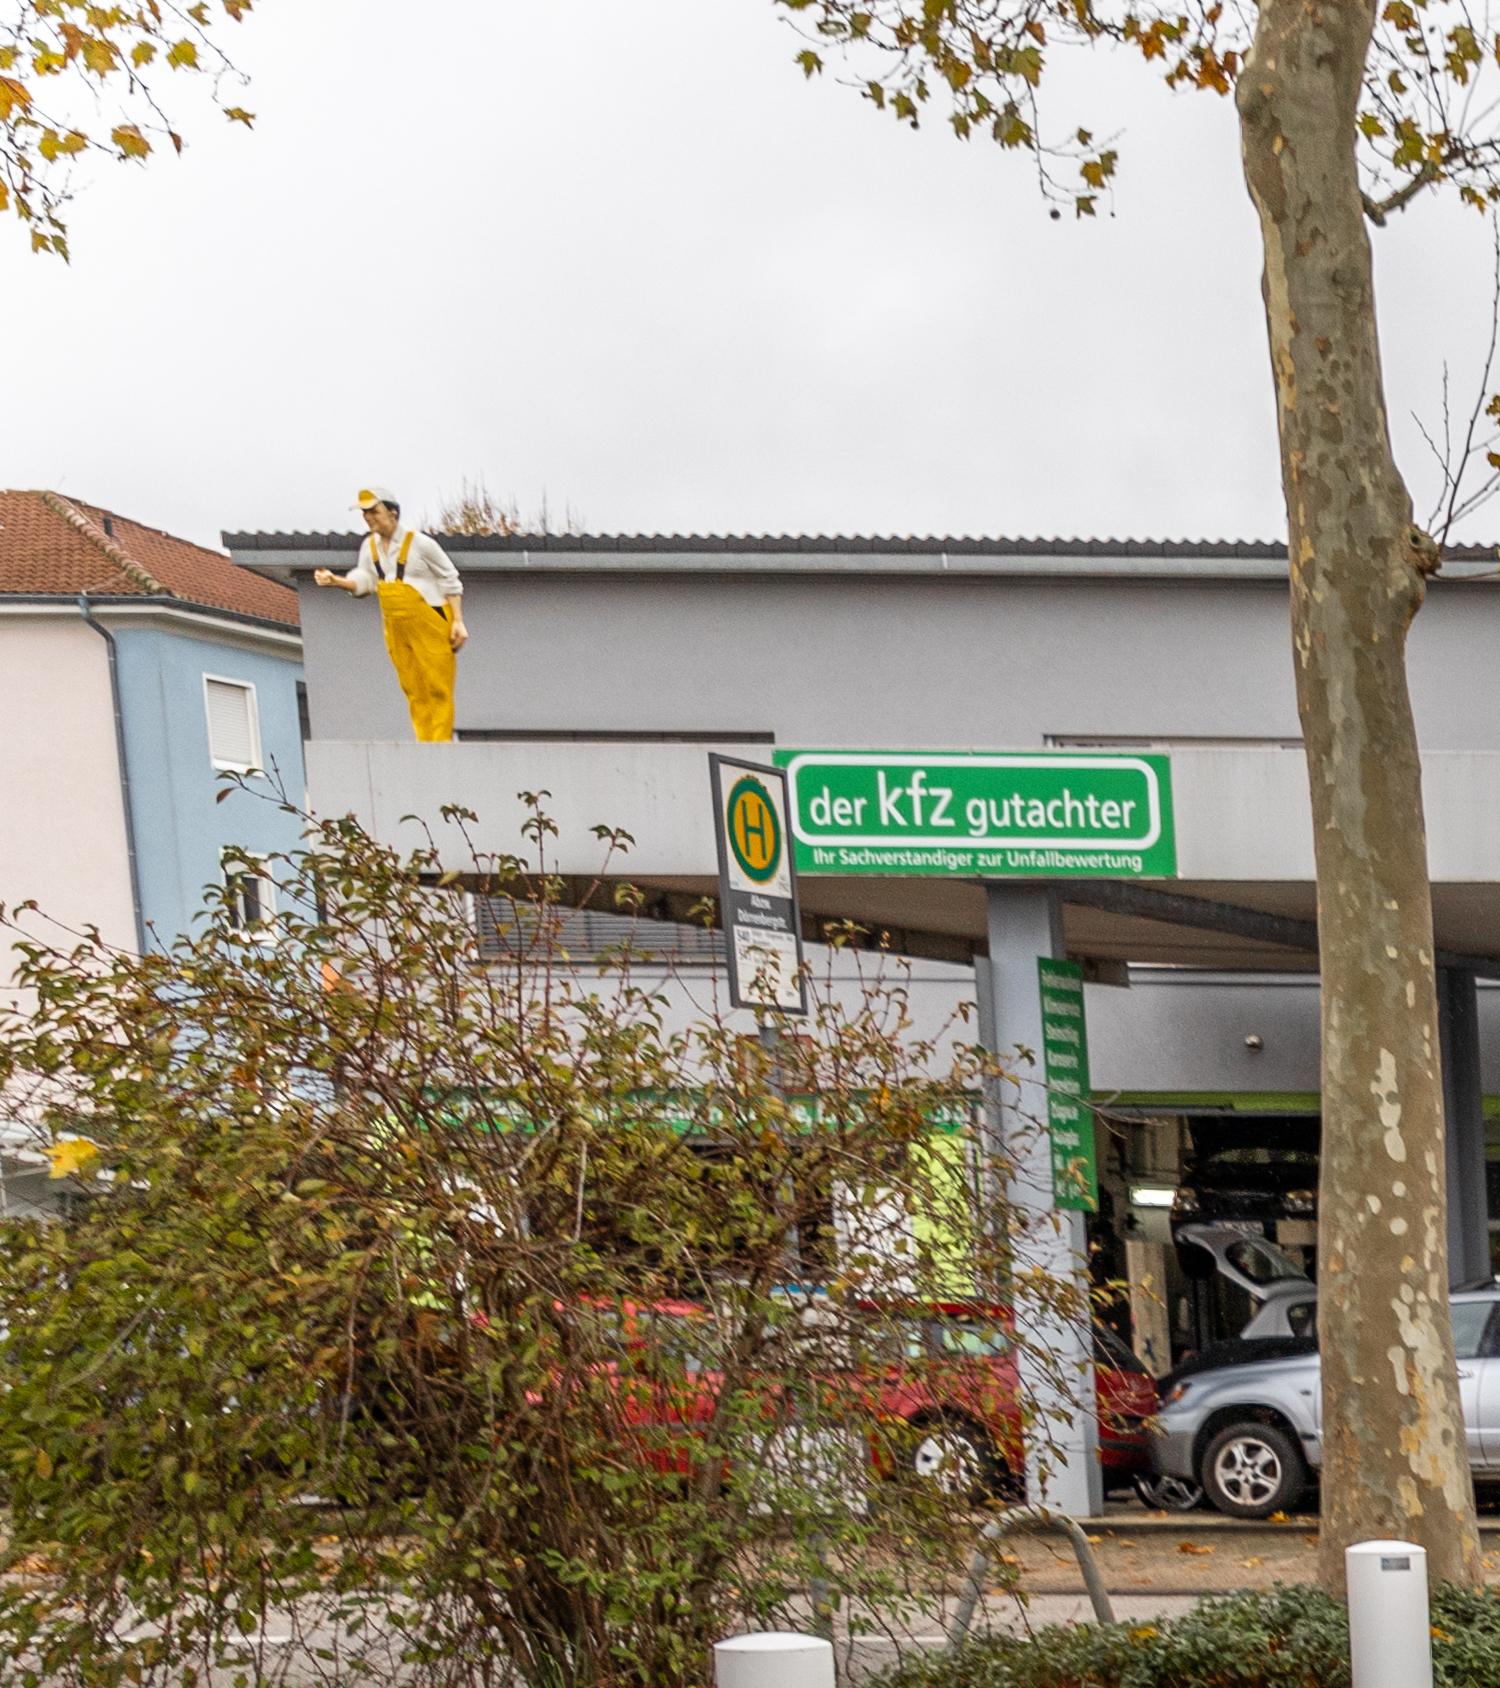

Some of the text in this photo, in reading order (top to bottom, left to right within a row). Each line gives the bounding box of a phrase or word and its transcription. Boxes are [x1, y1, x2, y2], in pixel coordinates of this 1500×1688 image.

[809, 769, 1137, 837] der kfz gutachter
[813, 848, 836, 865] Ihr
[977, 852, 1004, 867] zur
[1007, 850, 1143, 872] Unfallbewertung
